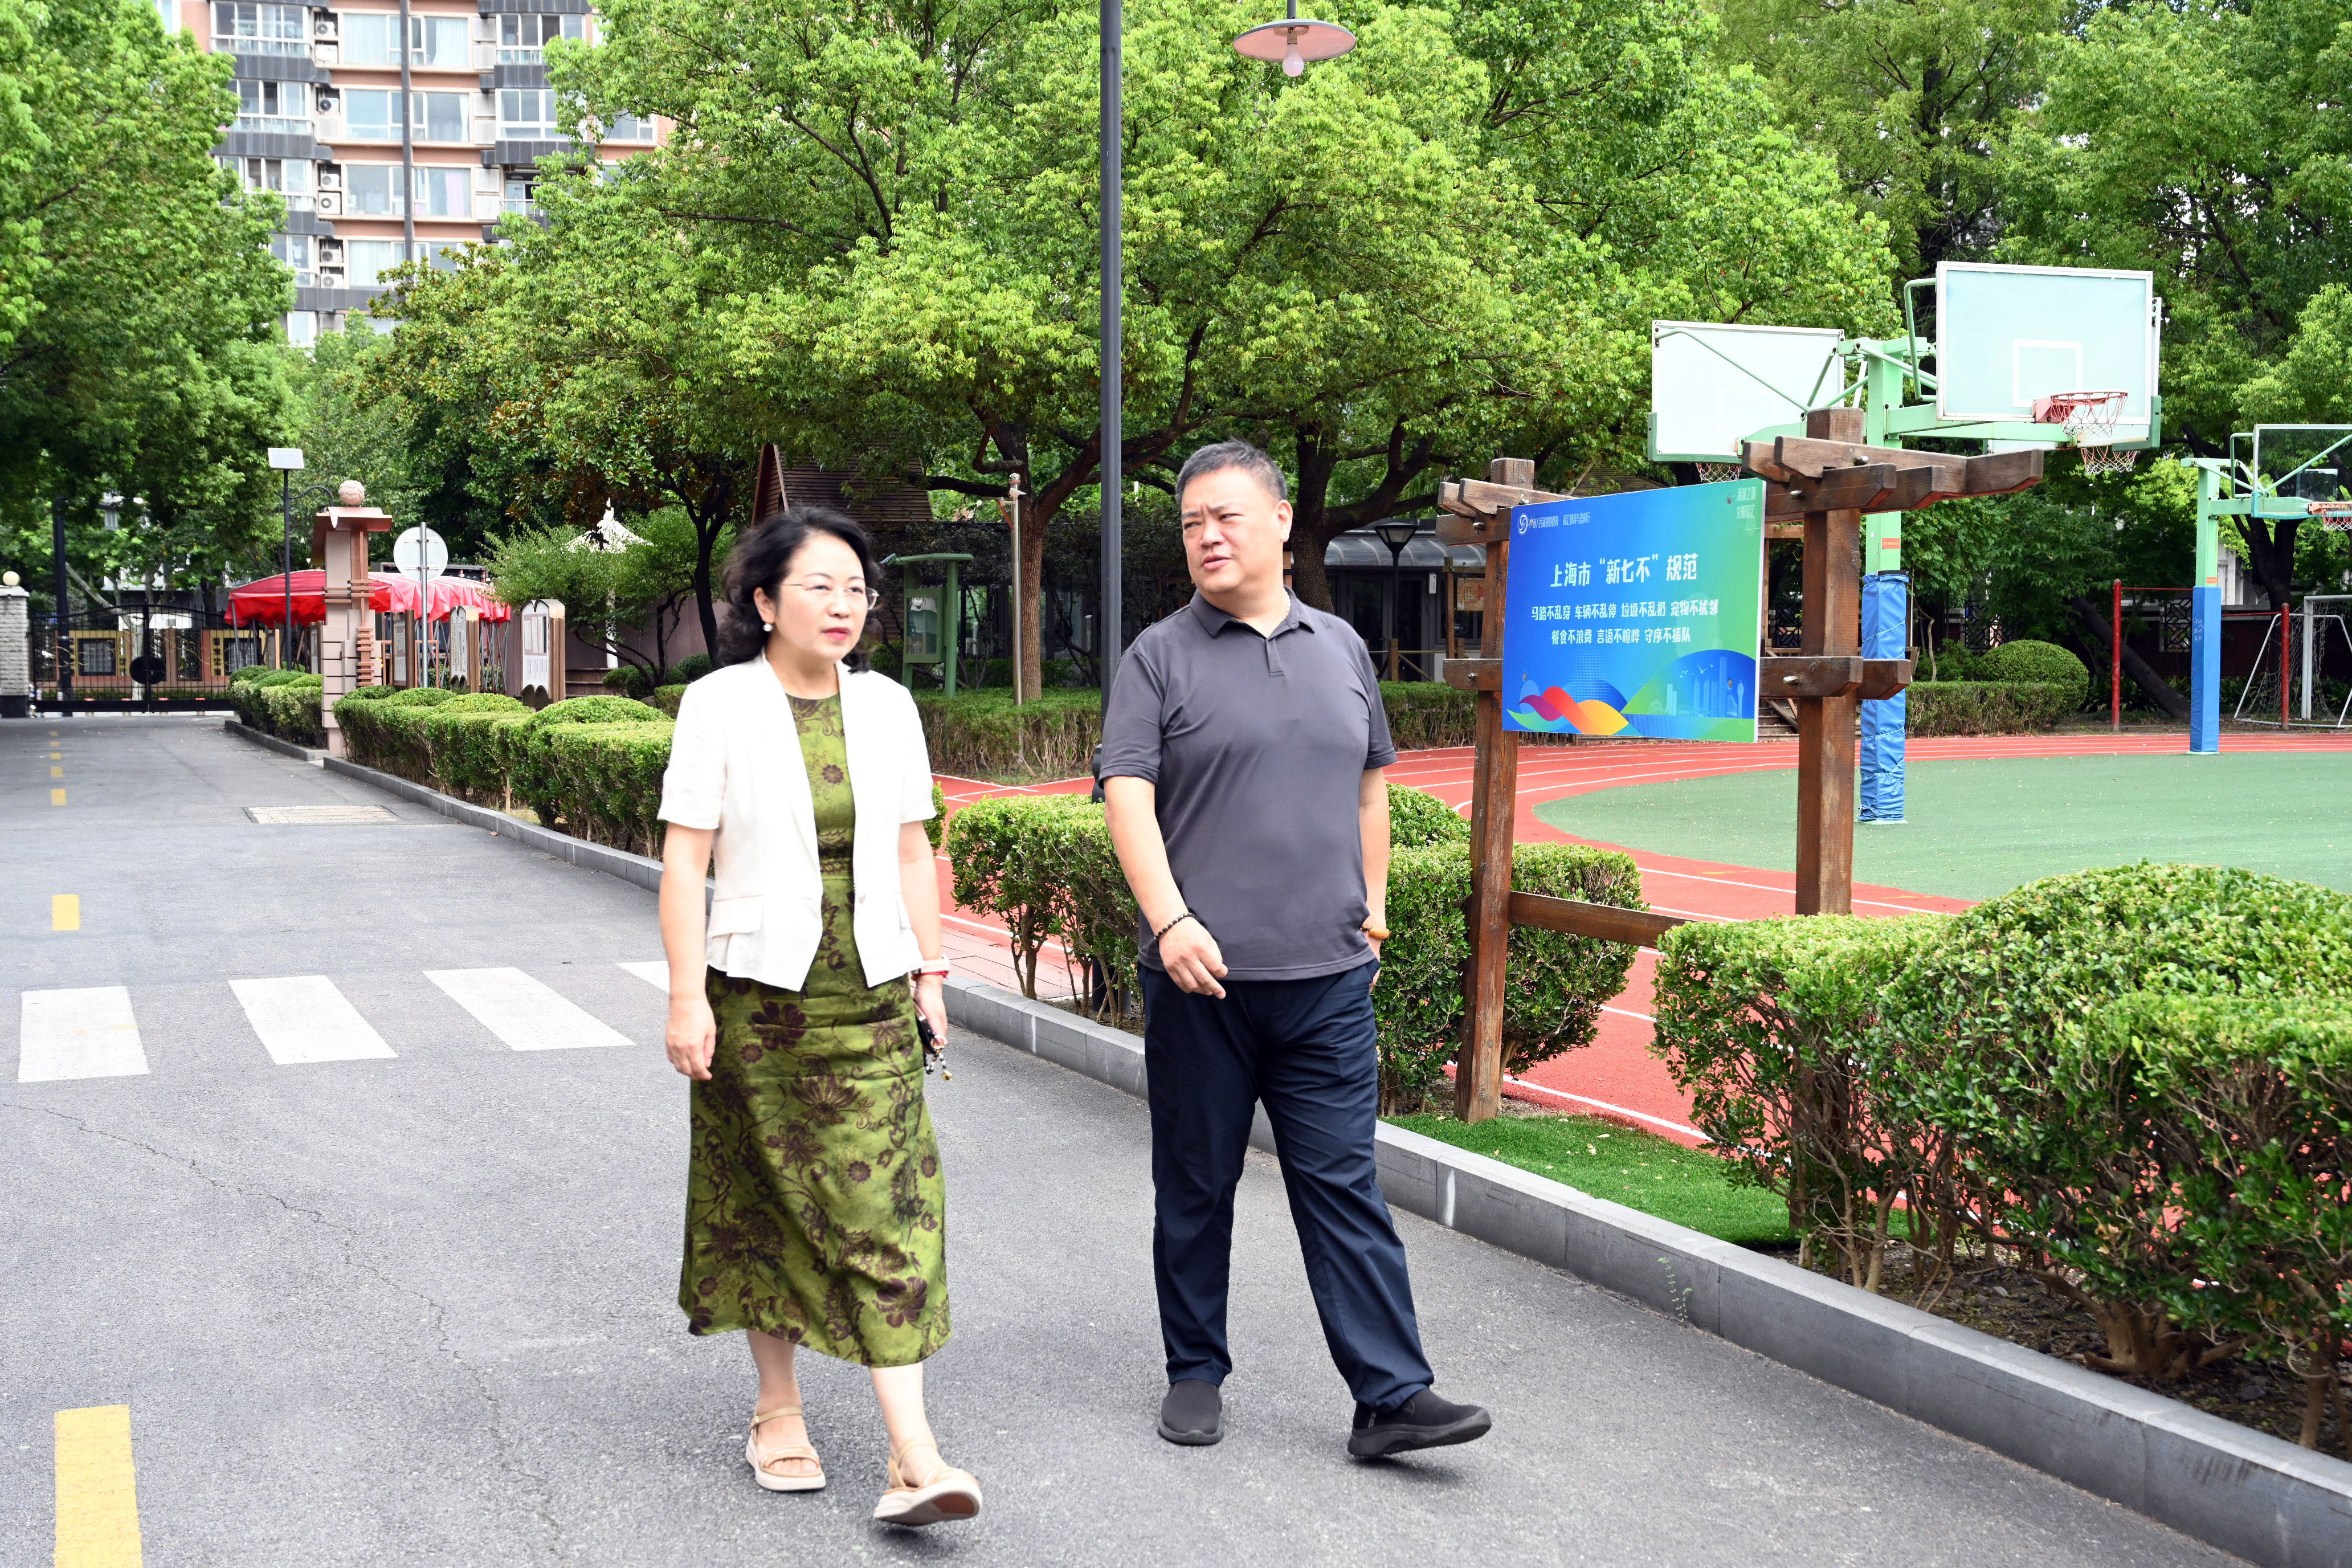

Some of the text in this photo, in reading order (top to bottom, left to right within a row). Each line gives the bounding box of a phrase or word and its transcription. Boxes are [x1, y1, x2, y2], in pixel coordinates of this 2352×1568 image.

[1550, 553, 1698, 587] 上海市 “新七不” 规范
[1531, 599, 1719, 620] 马路不乱穿 车辆不乱停 垃圾不乱扔 宠物不扰邻
[1551, 627, 1691, 645] 餐食不浪费 言语不喧哗 守序不插队
